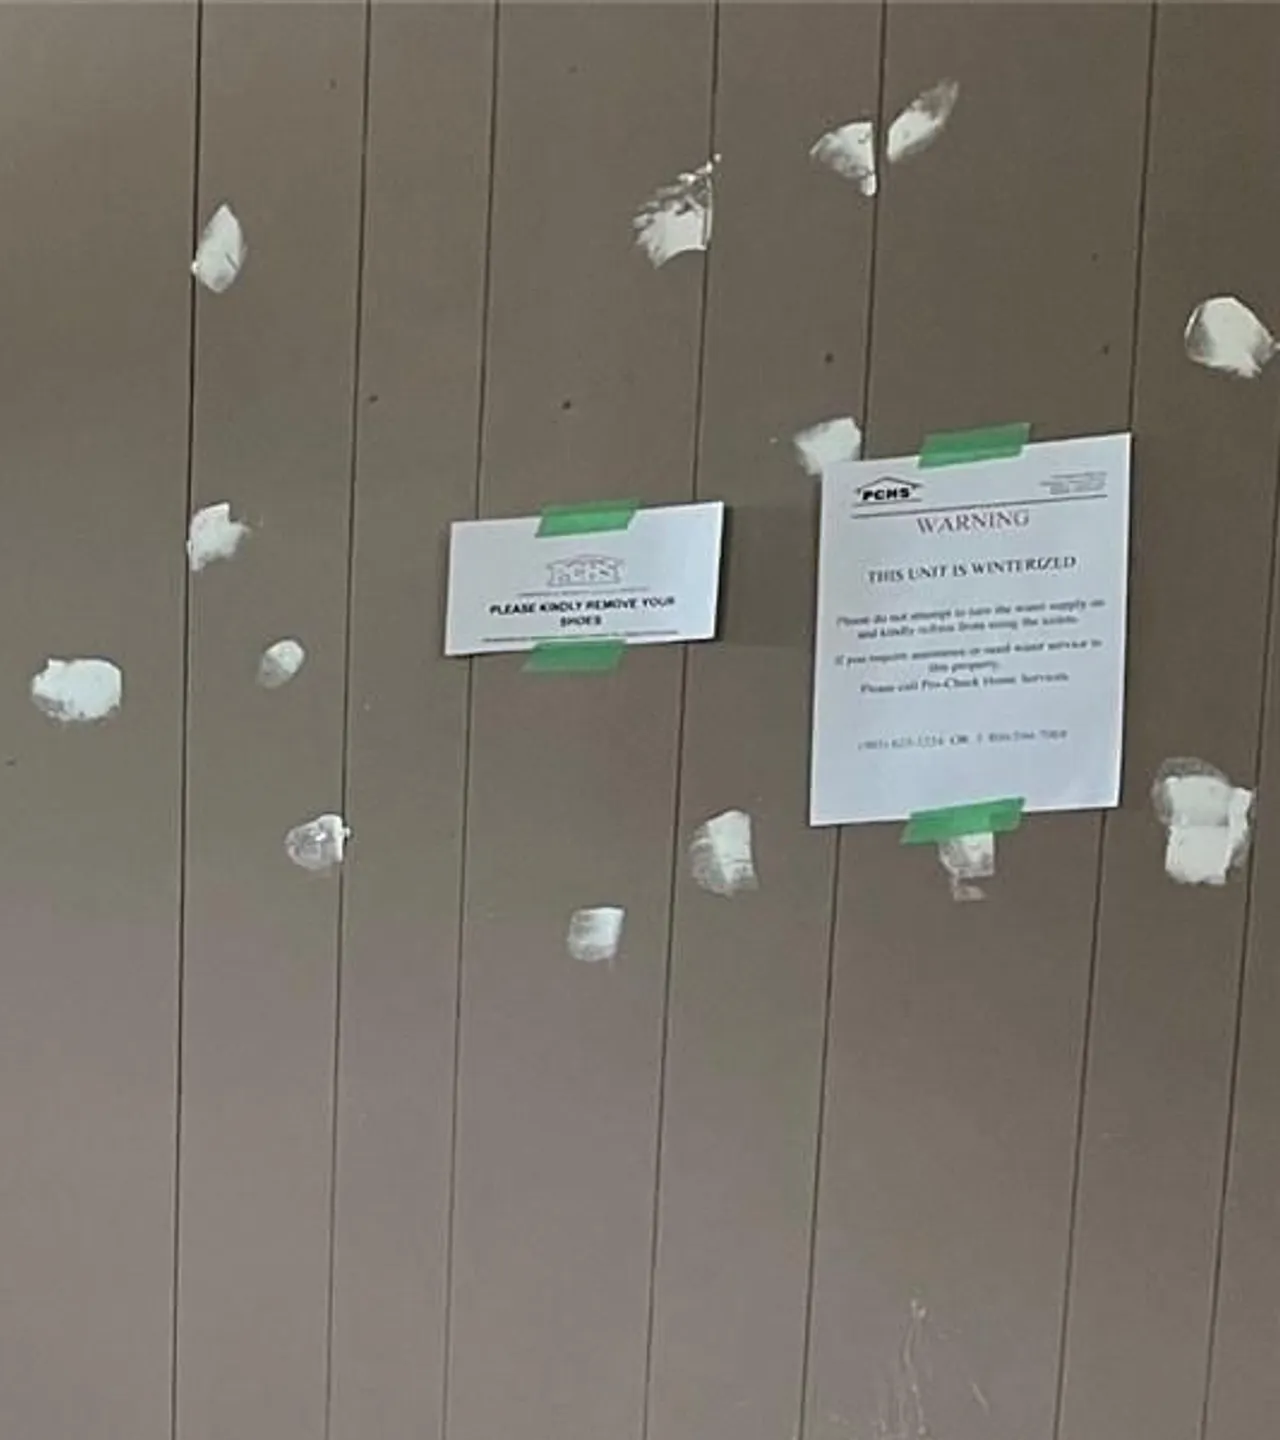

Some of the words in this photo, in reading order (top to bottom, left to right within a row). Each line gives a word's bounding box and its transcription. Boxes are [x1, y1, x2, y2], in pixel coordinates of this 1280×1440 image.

[862, 487, 911, 502] PCHS
[915, 509, 1031, 535] WARNING
[866, 568, 905, 585] THIS
[907, 565, 947, 582] UNIT
[952, 563, 968, 578] IS
[970, 555, 1078, 576] WINTERIZED
[489, 602, 536, 616] PLEASE
[539, 600, 583, 613] KINDLY
[585, 598, 637, 611] REMOVE
[641, 596, 676, 608] YOUR
[559, 614, 602, 628] SHOES
